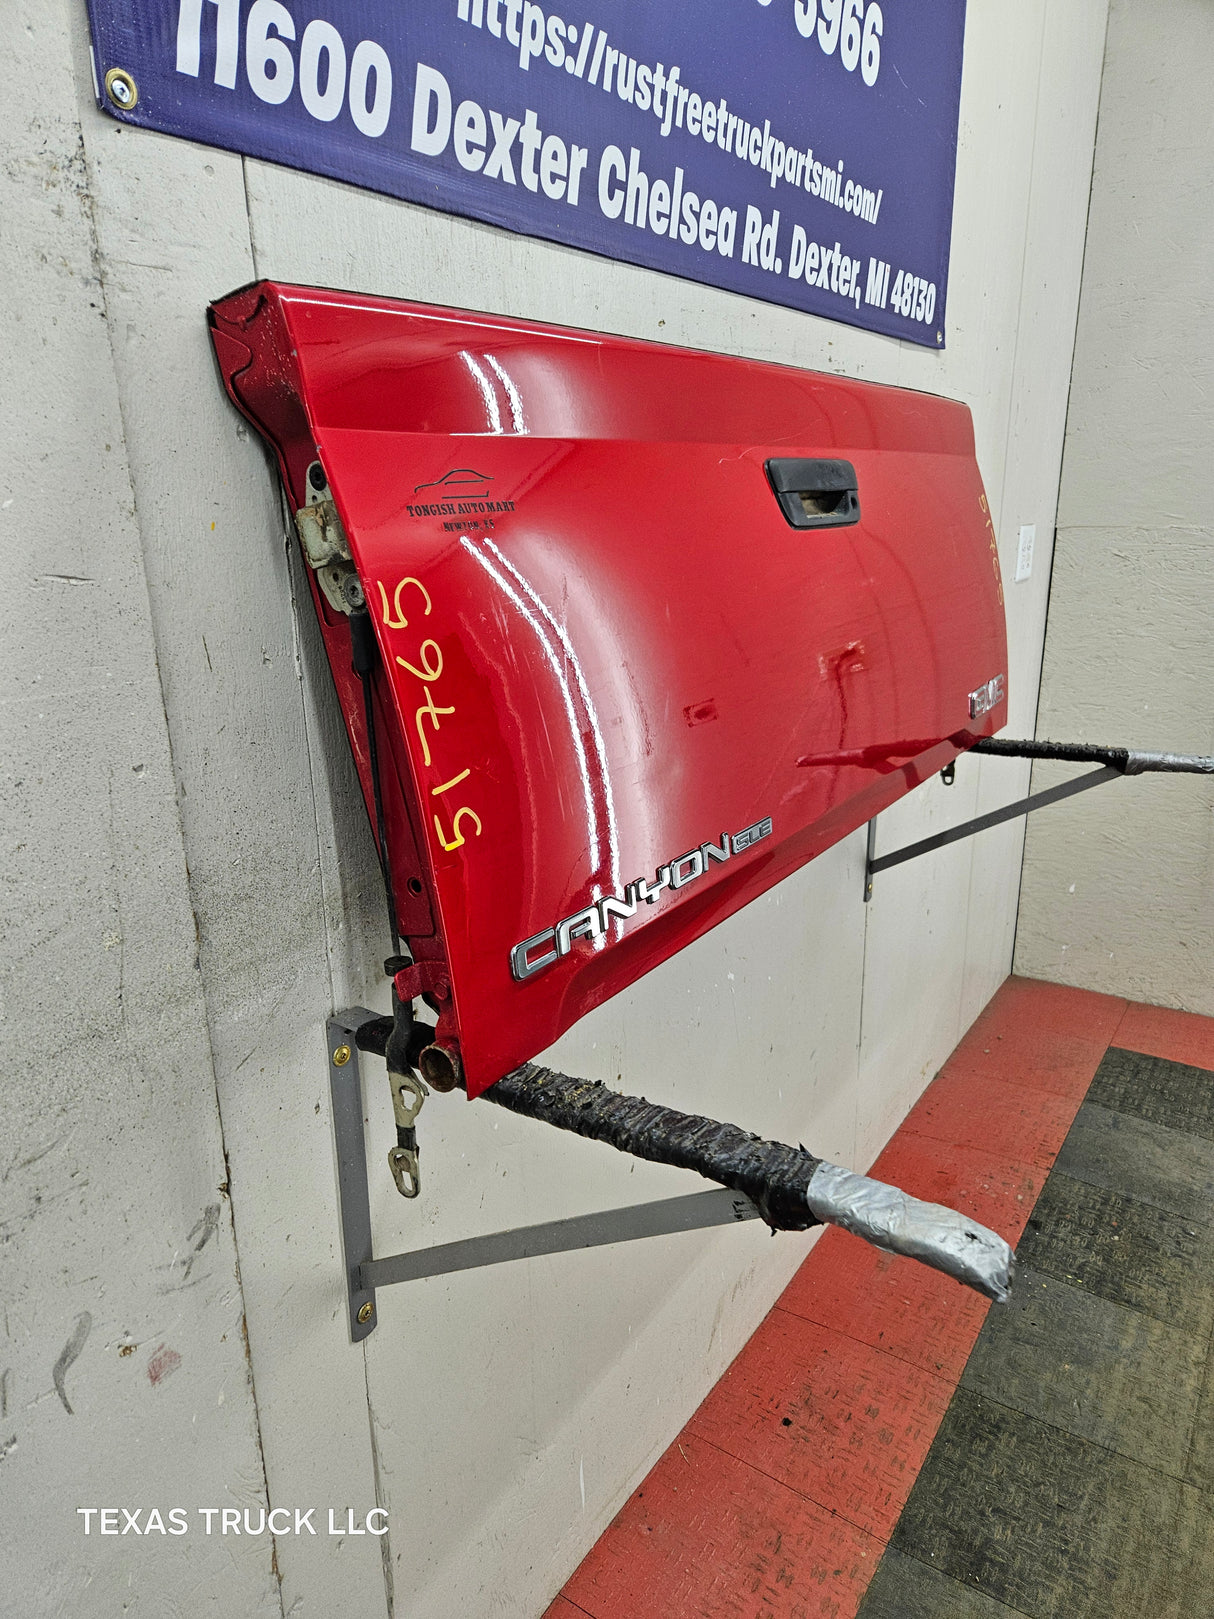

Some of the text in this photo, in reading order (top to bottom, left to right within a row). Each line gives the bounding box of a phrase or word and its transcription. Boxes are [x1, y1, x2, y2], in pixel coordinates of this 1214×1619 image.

[176, 0, 937, 325] 11600 Dexter Chelsea Rd. Dexter, MI 48130
[406, 503, 456, 517] TONGISH
[377, 577, 482, 852] 51765
[511, 817, 772, 981] CANYON SLE
